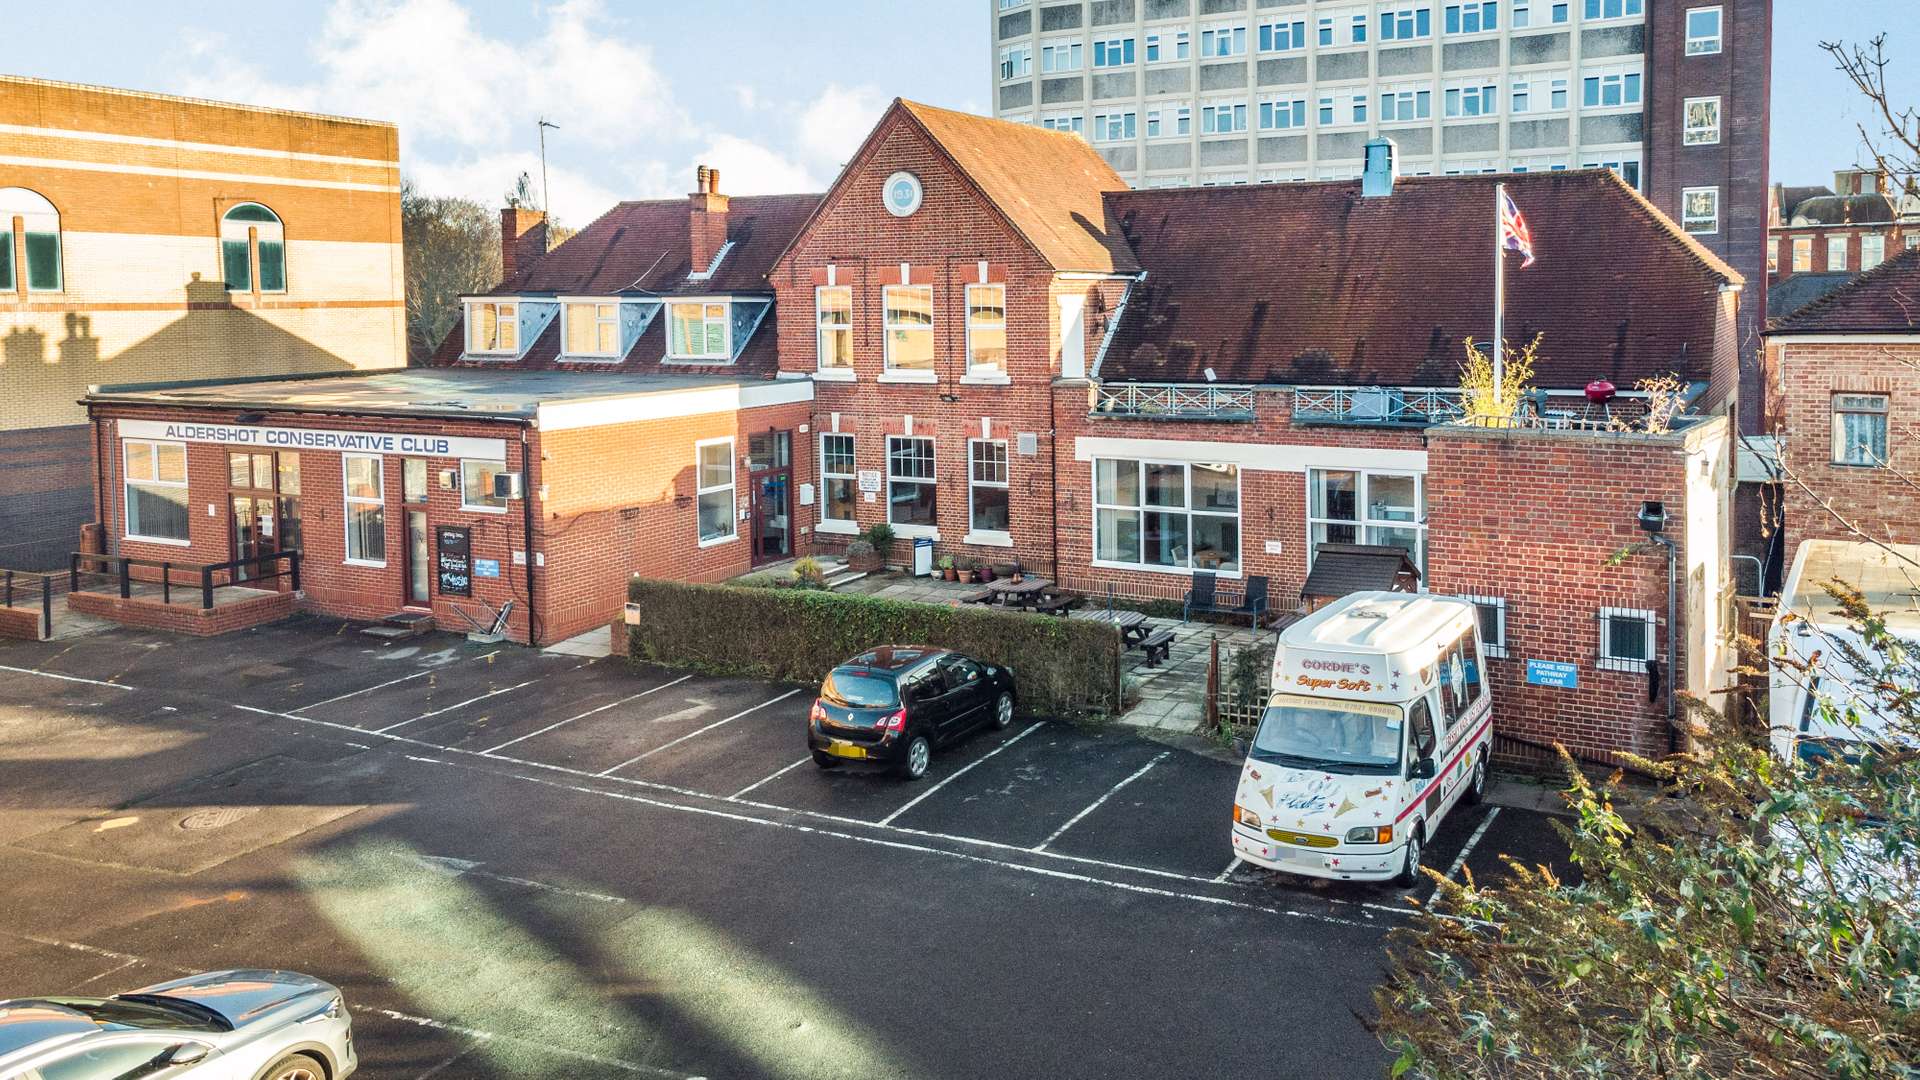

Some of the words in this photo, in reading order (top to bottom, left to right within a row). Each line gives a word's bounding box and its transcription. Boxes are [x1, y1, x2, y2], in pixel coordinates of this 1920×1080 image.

[165, 425, 259, 442] ALDERSHOT
[266, 430, 394, 450] CONSERVATIVE
[401, 437, 449, 454] CLUB
[1302, 658, 1370, 674] GORDIE'S
[1536, 670, 1568, 678] PATHWAY
[1296, 675, 1337, 691] Super
[1337, 678, 1372, 691] Soft
